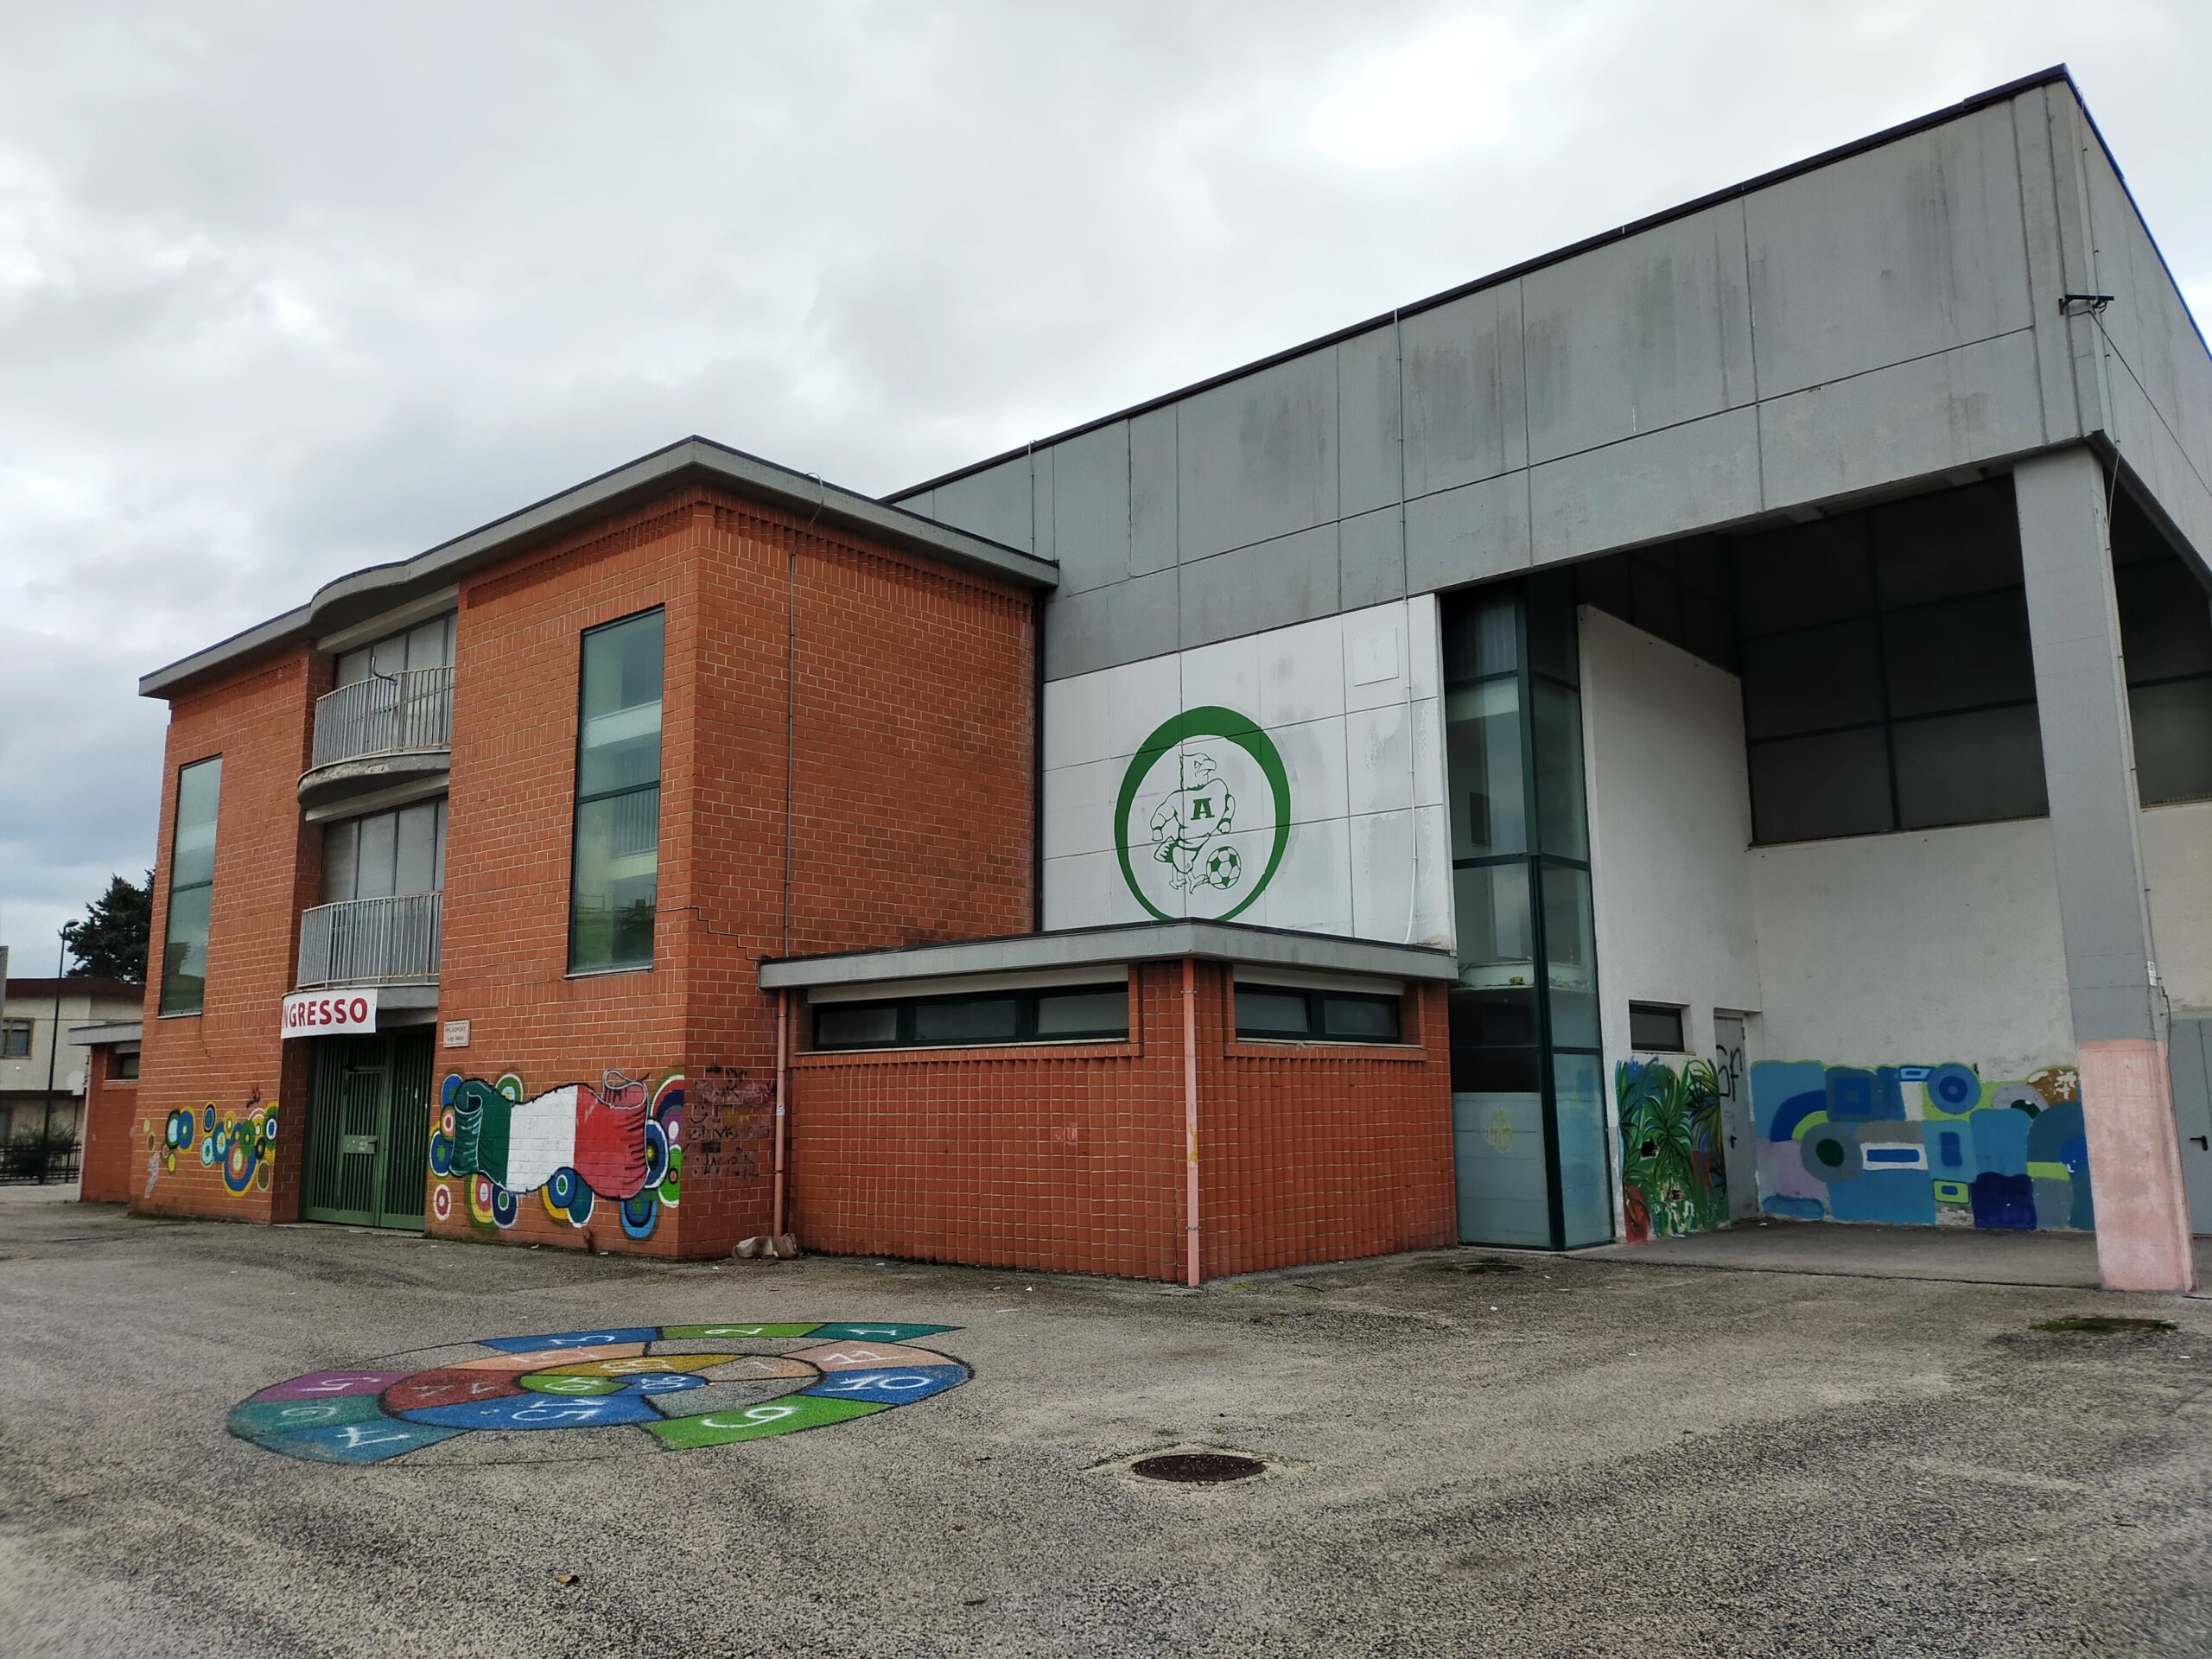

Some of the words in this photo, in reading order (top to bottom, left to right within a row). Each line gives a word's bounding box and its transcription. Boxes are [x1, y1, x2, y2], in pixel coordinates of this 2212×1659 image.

[1190, 798, 1216, 821] A
[300, 1376, 381, 1392] 5
[823, 1374, 933, 1392] 10
[512, 1399, 607, 1421] 15
[701, 1406, 798, 1428] 9
